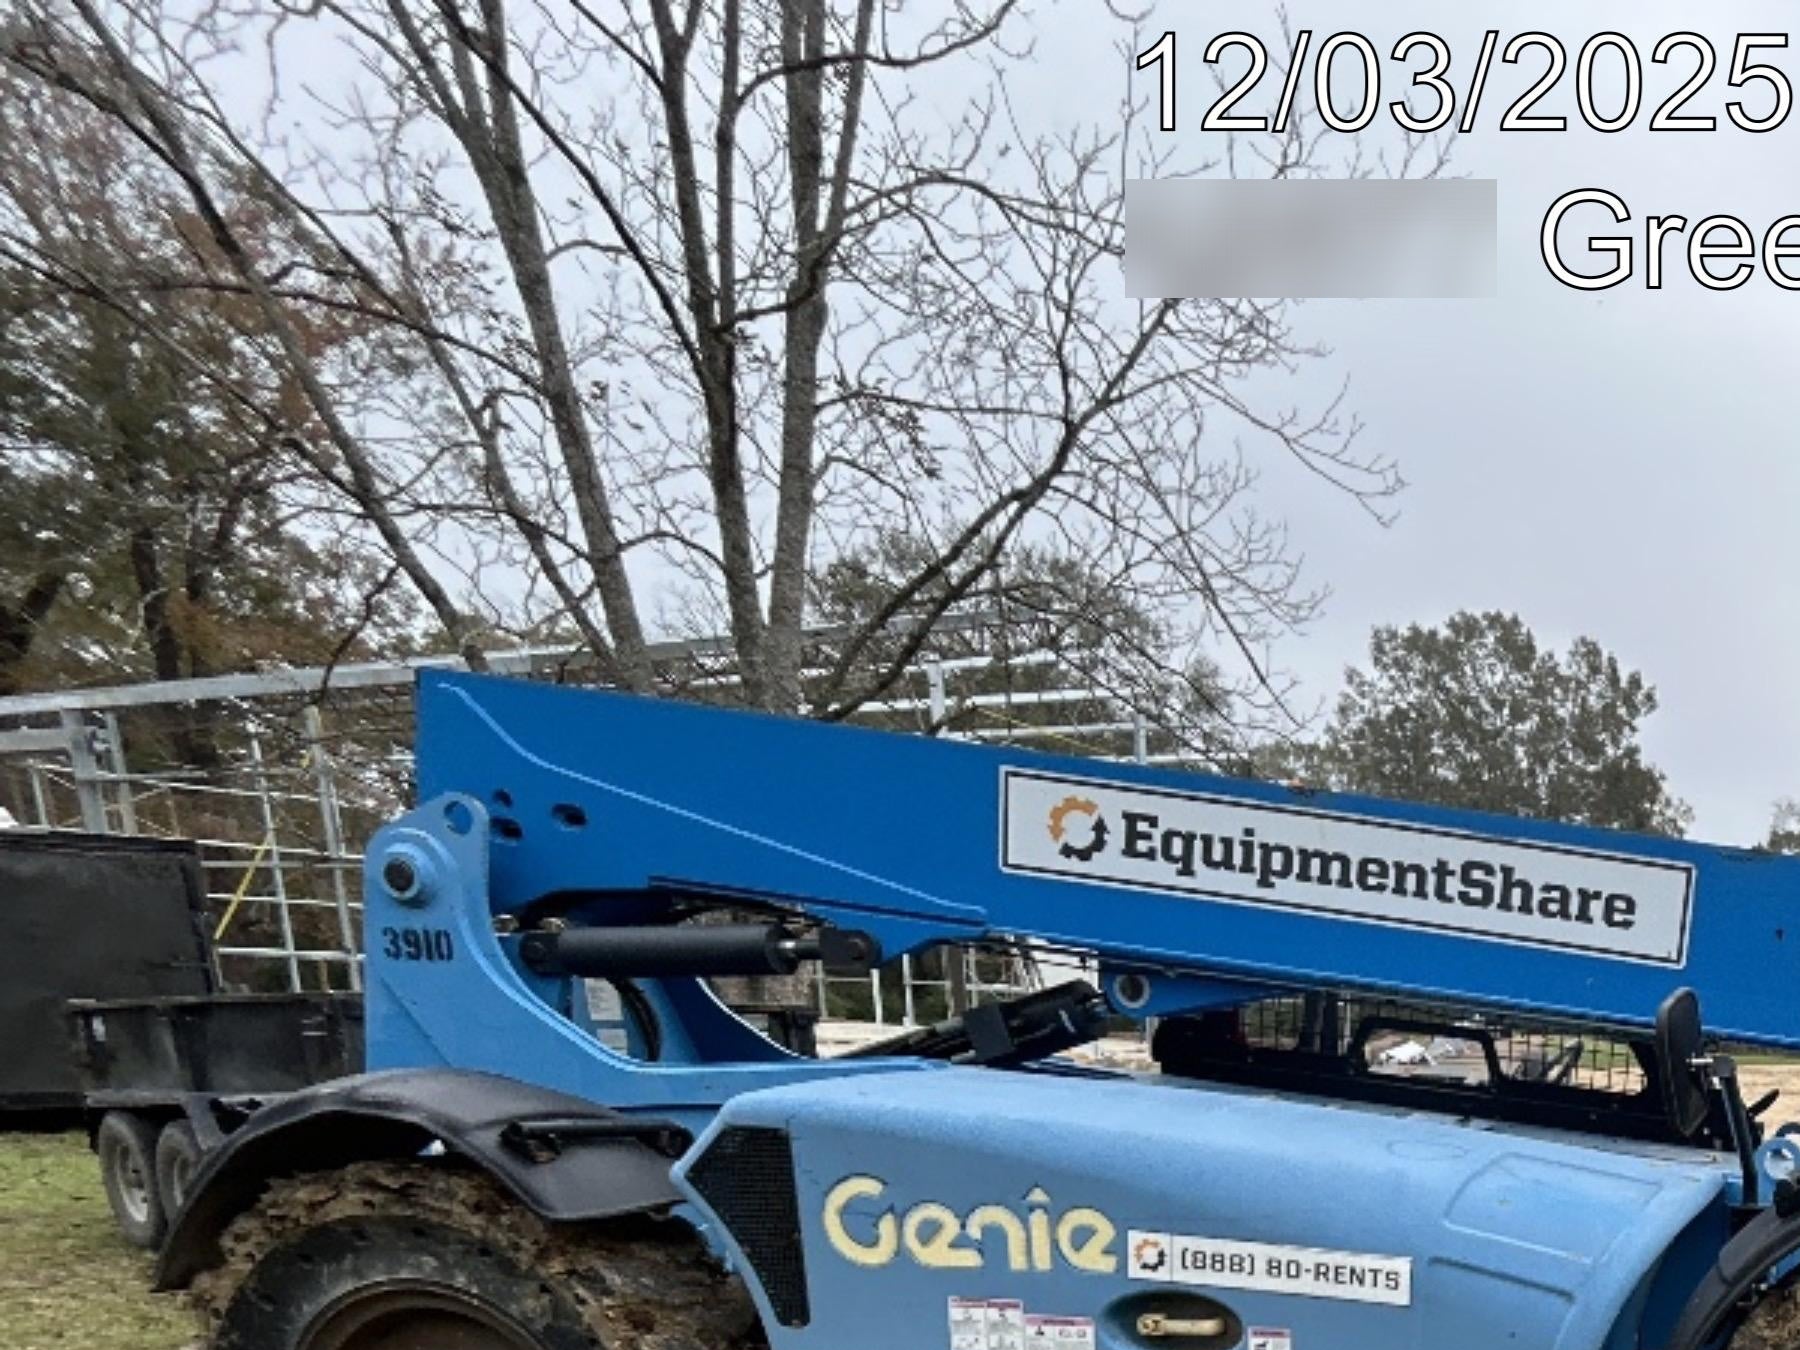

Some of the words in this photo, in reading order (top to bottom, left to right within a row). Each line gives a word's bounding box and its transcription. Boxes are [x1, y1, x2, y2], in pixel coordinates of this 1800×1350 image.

[1121, 809, 1637, 930] EquipmentShare
[382, 927, 454, 962] 3910
[822, 1174, 1119, 1273] Genie
